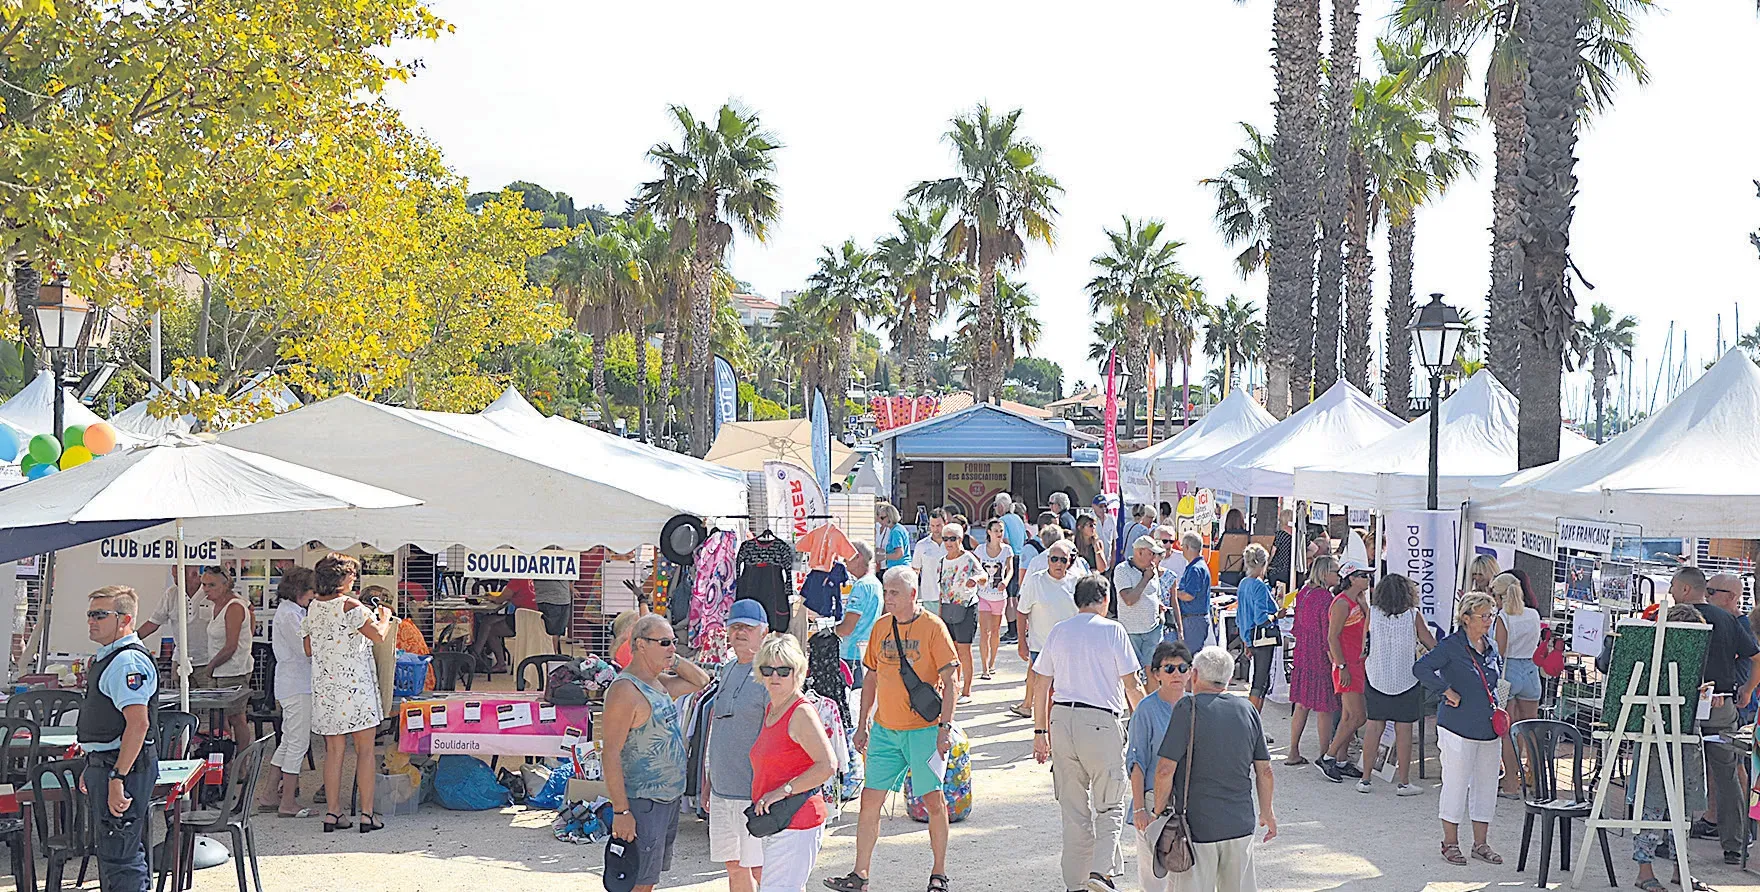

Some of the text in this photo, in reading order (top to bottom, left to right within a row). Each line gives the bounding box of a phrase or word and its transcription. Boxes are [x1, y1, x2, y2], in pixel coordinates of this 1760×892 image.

[964, 463, 991, 473] FORUM
[961, 473, 1007, 481] ASSOCIATIONS
[101, 538, 217, 560] CLUB DE BIDGE
[467, 553, 576, 575] SOULIDARITA
[1421, 548, 1435, 615] BANQUE
[434, 738, 480, 751] Soulidarita
